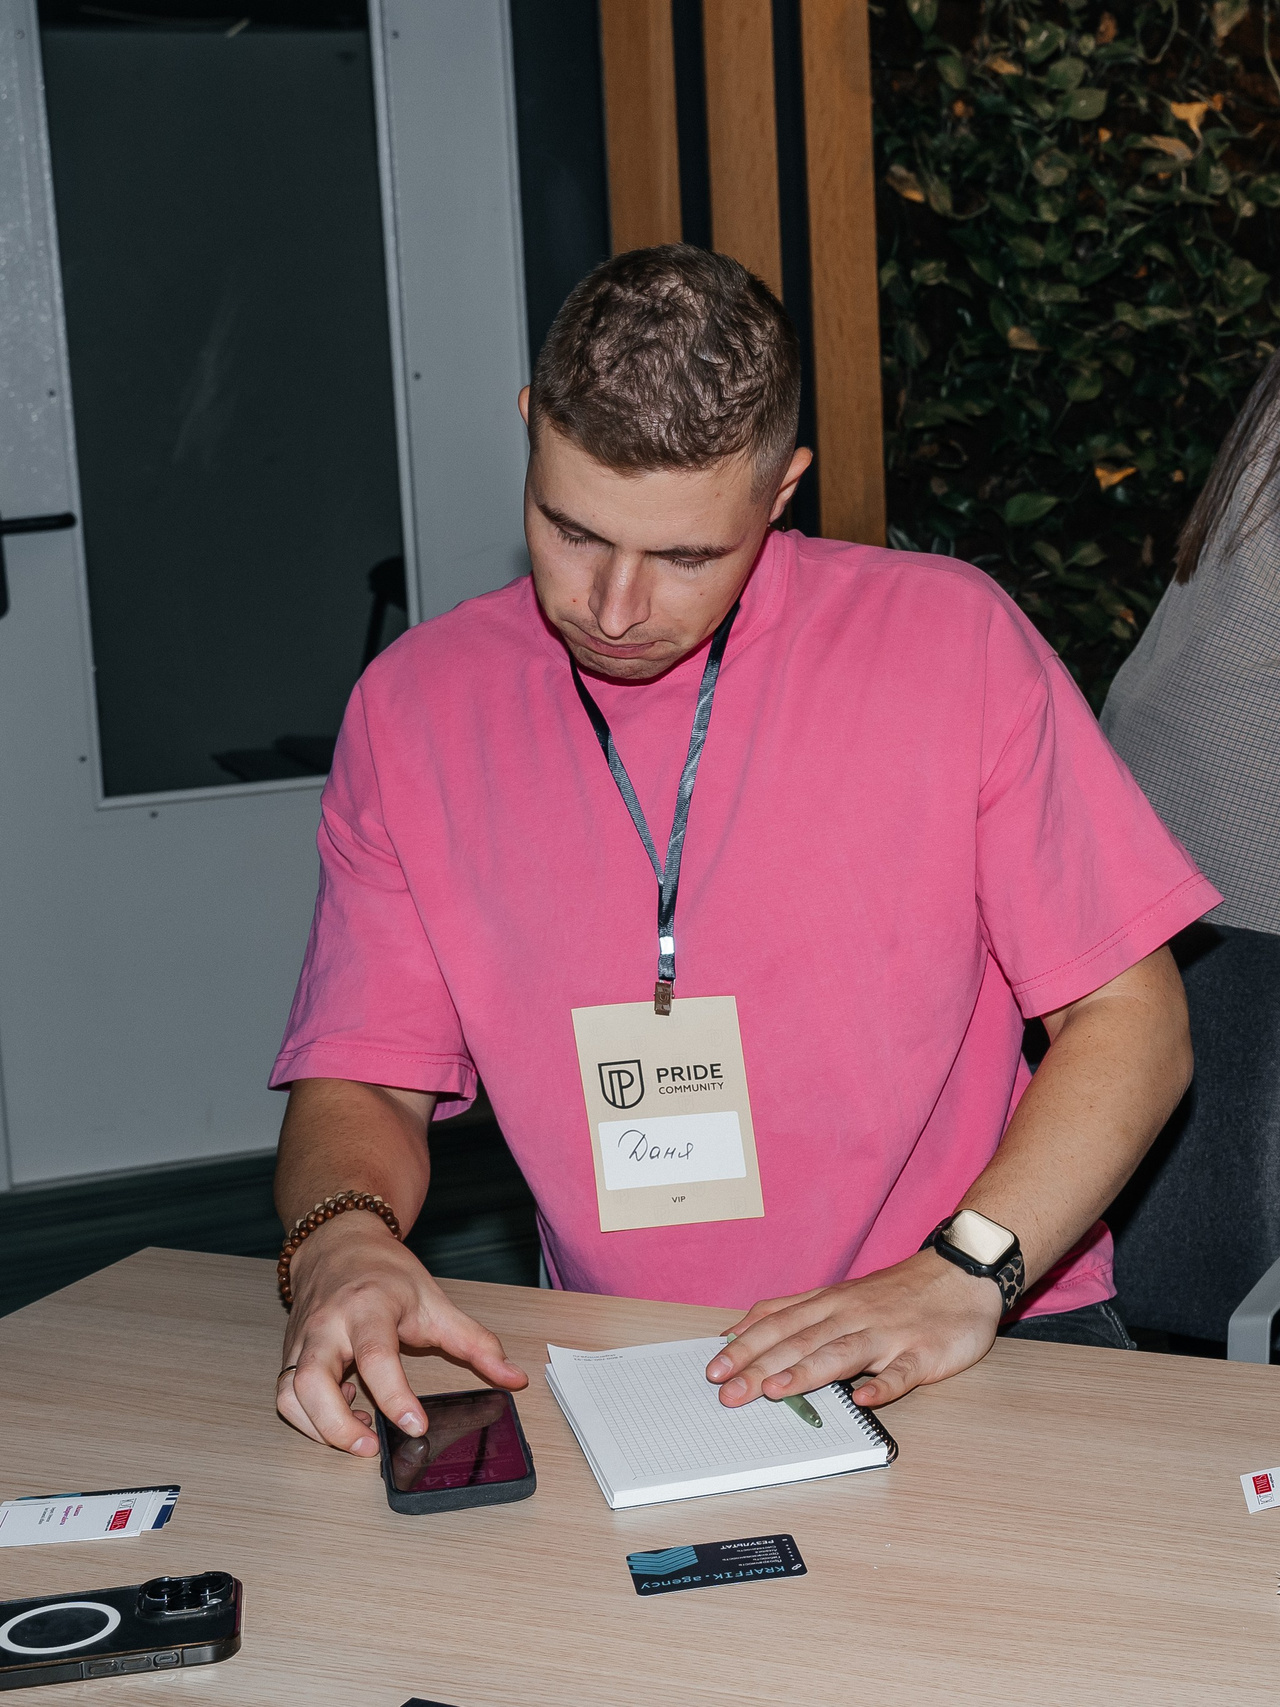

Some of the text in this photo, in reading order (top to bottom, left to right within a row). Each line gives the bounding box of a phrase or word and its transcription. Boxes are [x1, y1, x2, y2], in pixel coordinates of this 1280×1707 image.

[656, 1063, 723, 1083] PRIDE
[658, 1082, 724, 1095] COMMUNITY
[617, 1129, 694, 1161] Даня
[671, 1195, 686, 1203] VIP
[720, 1539, 774, 1550] РЕЗУЛЬТАТ
[640, 1565, 785, 1590] KRAFFIK.agency
